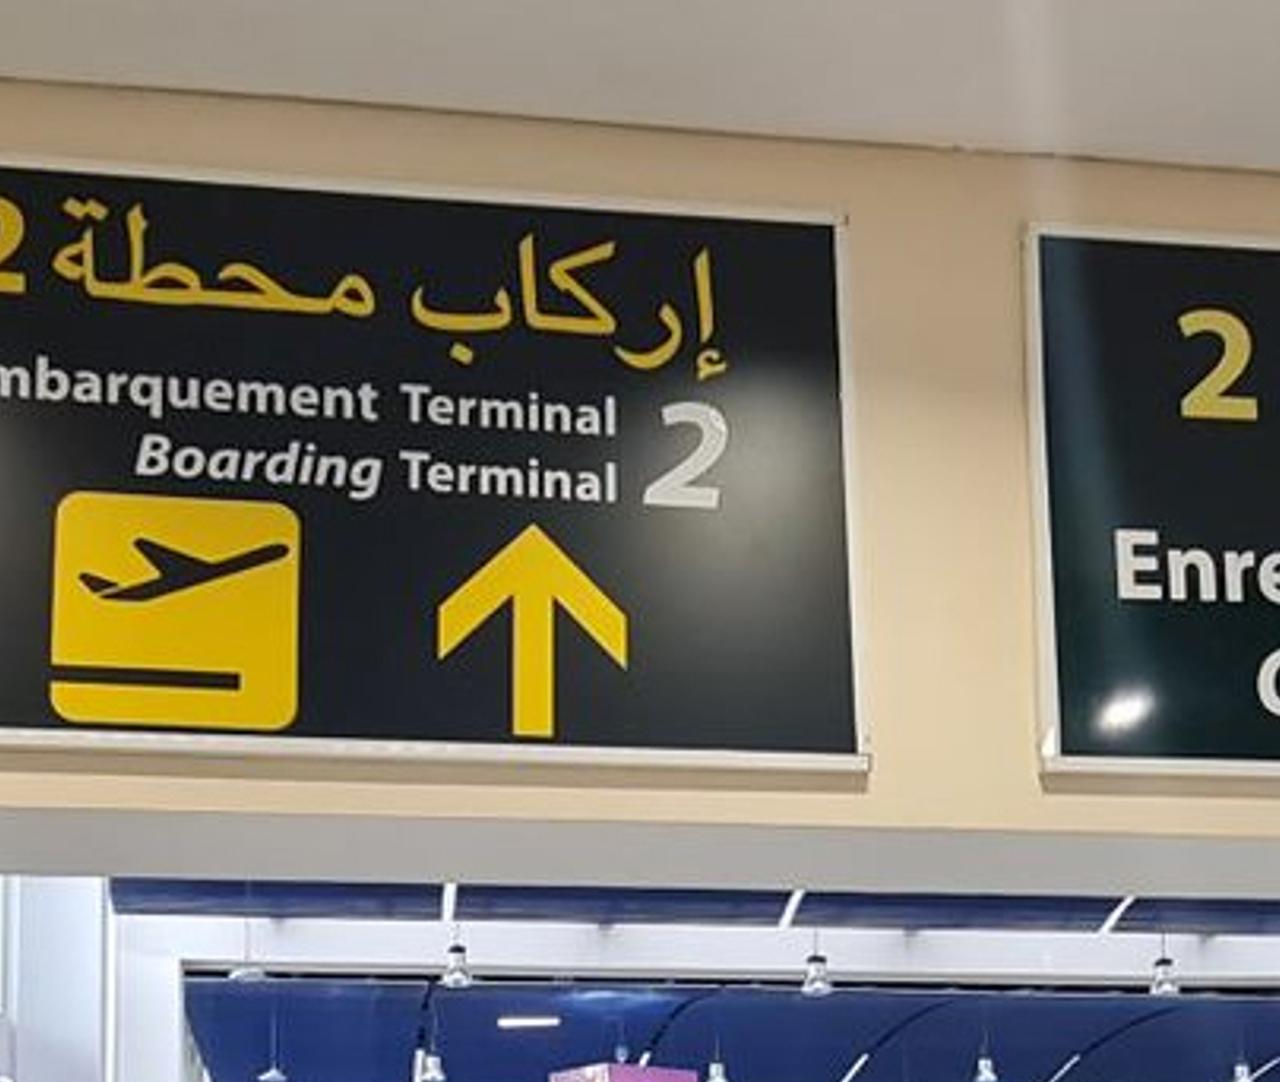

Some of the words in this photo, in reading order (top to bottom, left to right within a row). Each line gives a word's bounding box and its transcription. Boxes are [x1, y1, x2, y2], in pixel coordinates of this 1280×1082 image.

[51, 196, 377, 316] محطة
[410, 233, 728, 380] إركاب
[400, 383, 618, 436] Terminal
[1176, 308, 1259, 422] 2
[135, 434, 383, 500] Boarding
[399, 451, 619, 503] Terminal
[641, 402, 730, 509] 2
